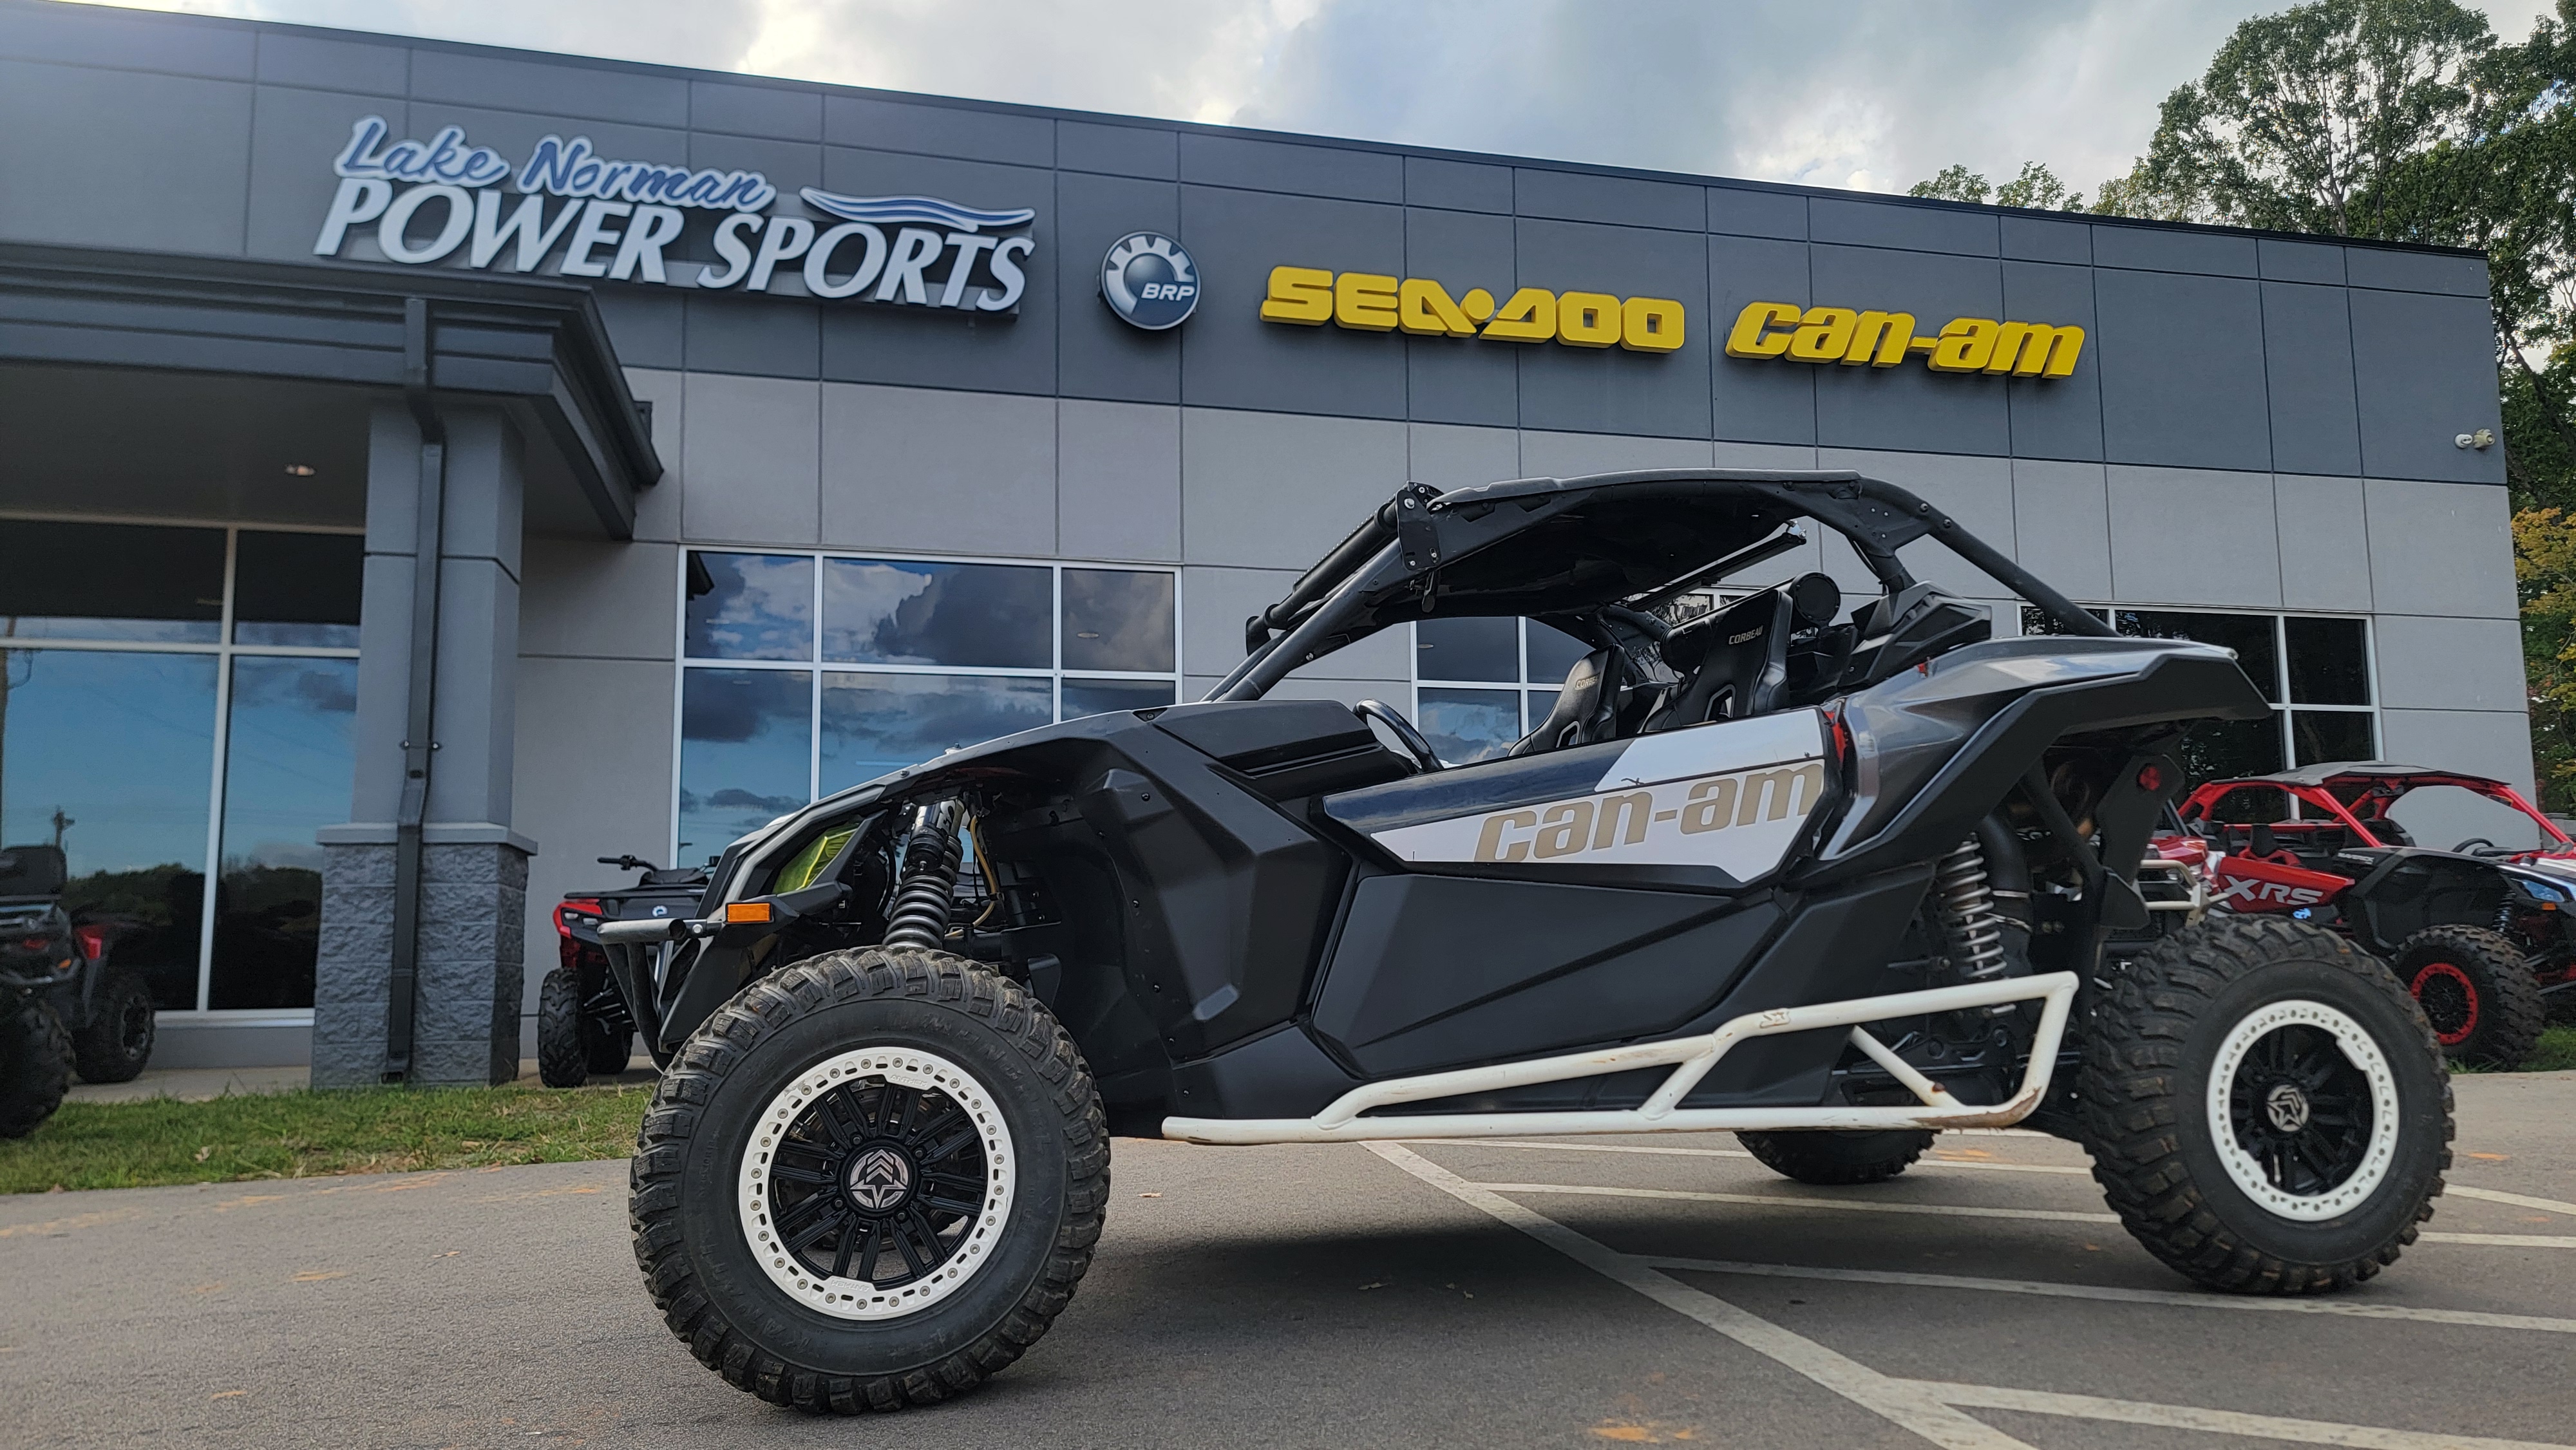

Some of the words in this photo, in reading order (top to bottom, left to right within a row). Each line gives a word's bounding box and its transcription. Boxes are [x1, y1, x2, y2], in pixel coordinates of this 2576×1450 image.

[334, 115, 511, 187] Lake
[516, 133, 777, 212] Norman
[313, 179, 683, 283] POWER
[697, 214, 1035, 312] SPORTS
[1141, 282, 1195, 301] BRP
[1728, 625, 1763, 645] CORBEAU
[1576, 675, 1600, 688] CORBEA
[2224, 874, 2324, 905] XRS
[890, 1075, 928, 1087] ANTHEM
